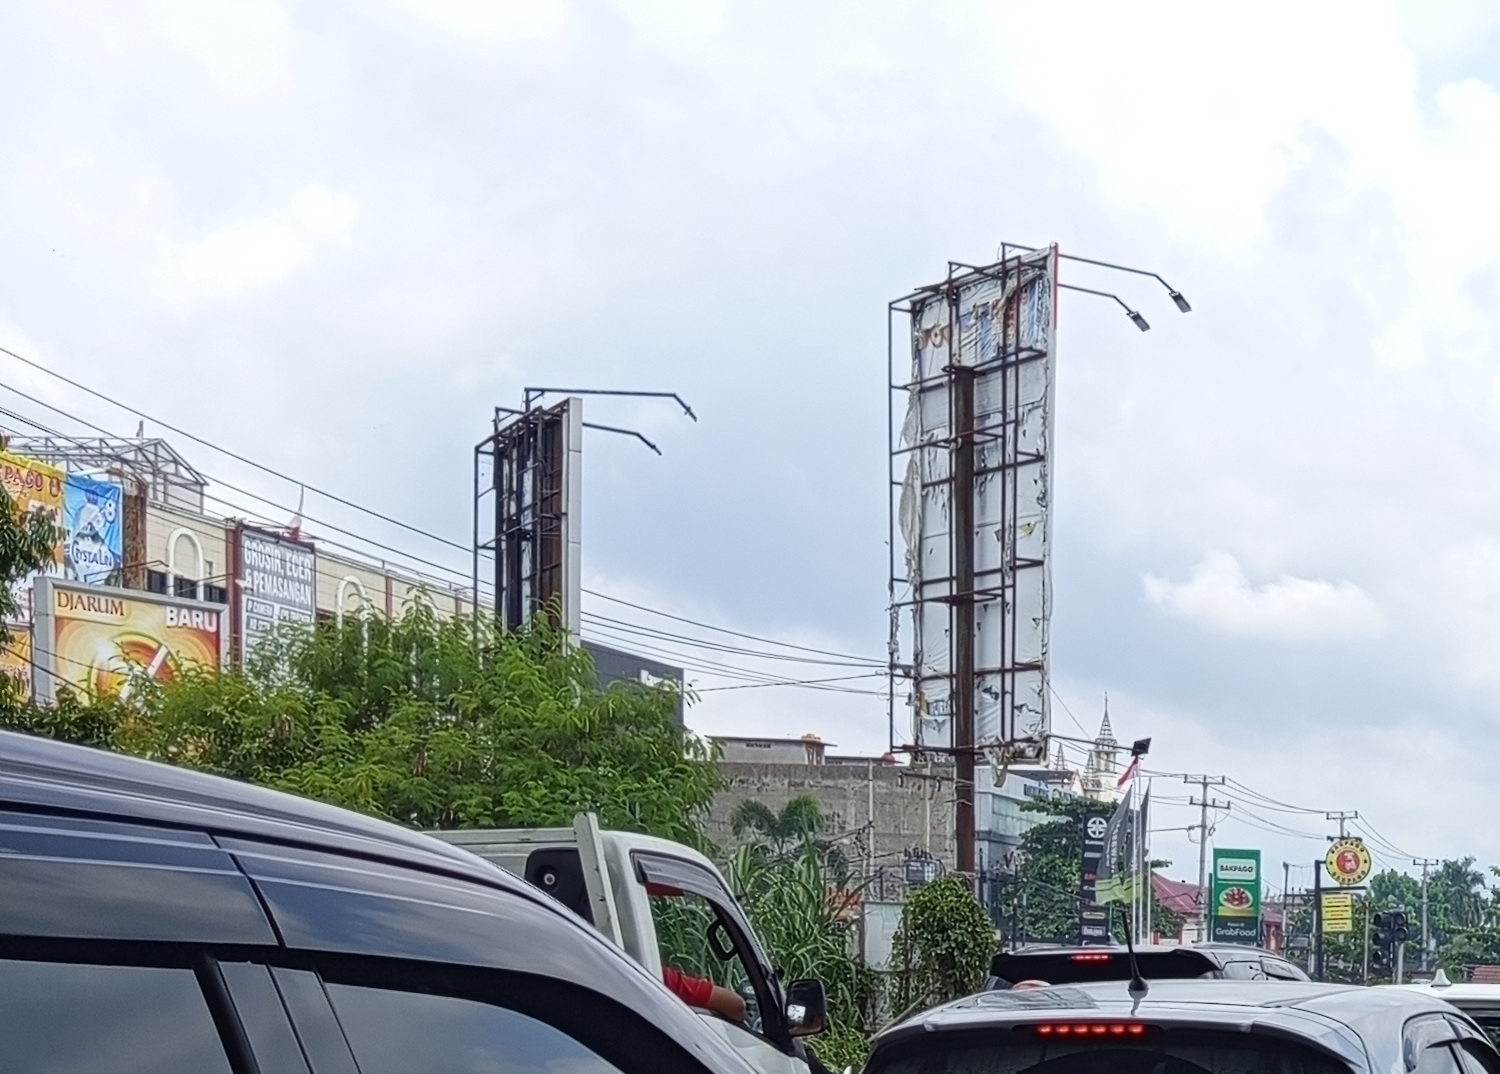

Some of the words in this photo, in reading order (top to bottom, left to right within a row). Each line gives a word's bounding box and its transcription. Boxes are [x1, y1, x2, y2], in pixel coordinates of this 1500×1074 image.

[0, 463, 44, 491] PAGO
[286, 553, 312, 583] ECER
[253, 572, 312, 606] PEMASANGAN
[57, 591, 125, 616] DJARUM
[166, 605, 217, 632] BARU
[1220, 865, 1254, 873] BAKPAGO
[1216, 927, 1256, 937] GrabFood
